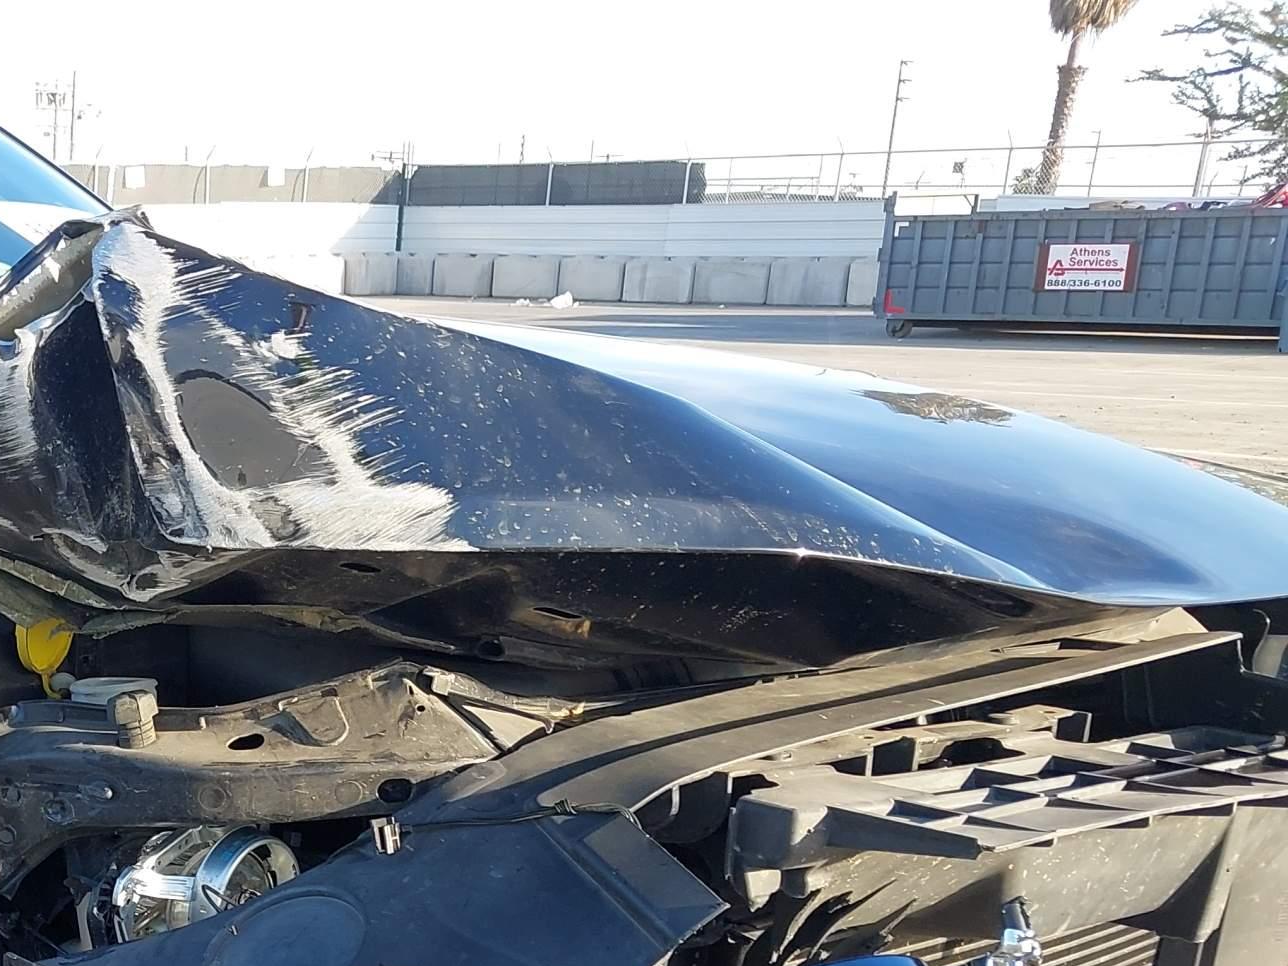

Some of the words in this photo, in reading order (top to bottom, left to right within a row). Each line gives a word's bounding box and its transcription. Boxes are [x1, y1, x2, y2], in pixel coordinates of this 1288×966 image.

[1070, 247, 1111, 257] Athens
[1068, 257, 1119, 267] Services
[1047, 279, 1122, 288] 888/336-6100
